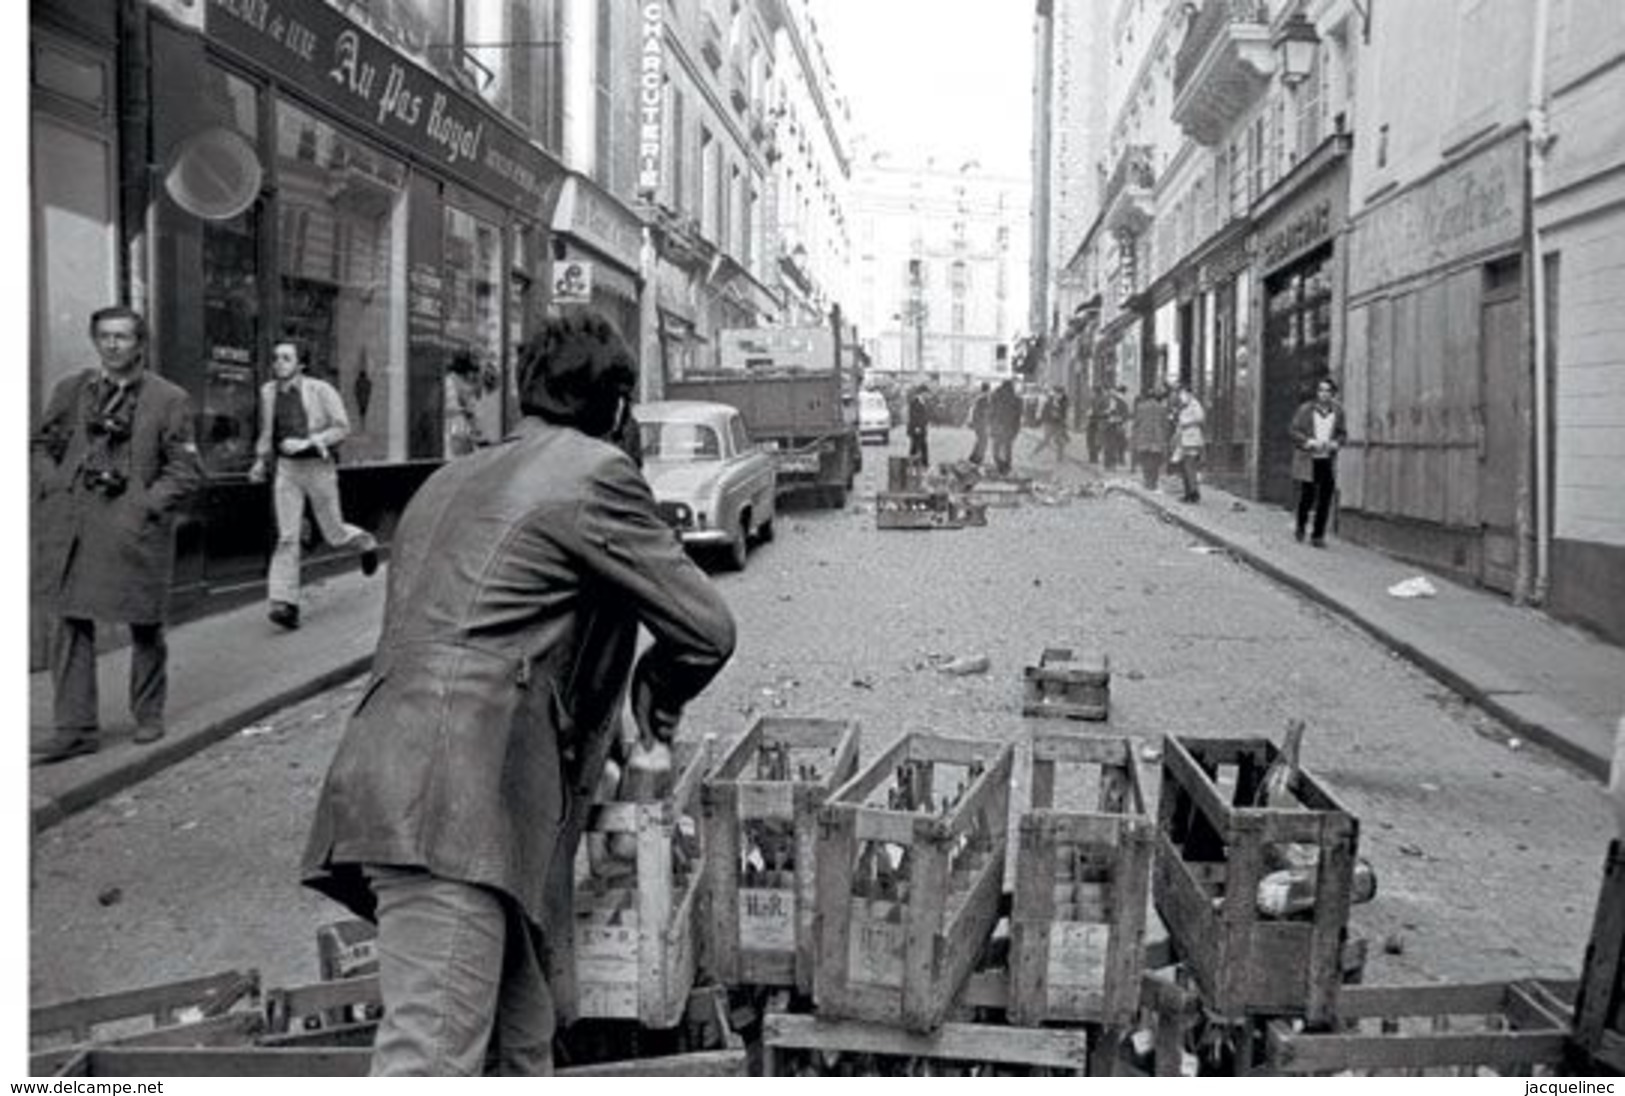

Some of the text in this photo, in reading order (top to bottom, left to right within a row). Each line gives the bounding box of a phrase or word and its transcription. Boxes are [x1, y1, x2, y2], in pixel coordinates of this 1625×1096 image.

[330, 30, 483, 163] Au Pas Royal
[640, 3, 664, 187] CHARCUTERIE
